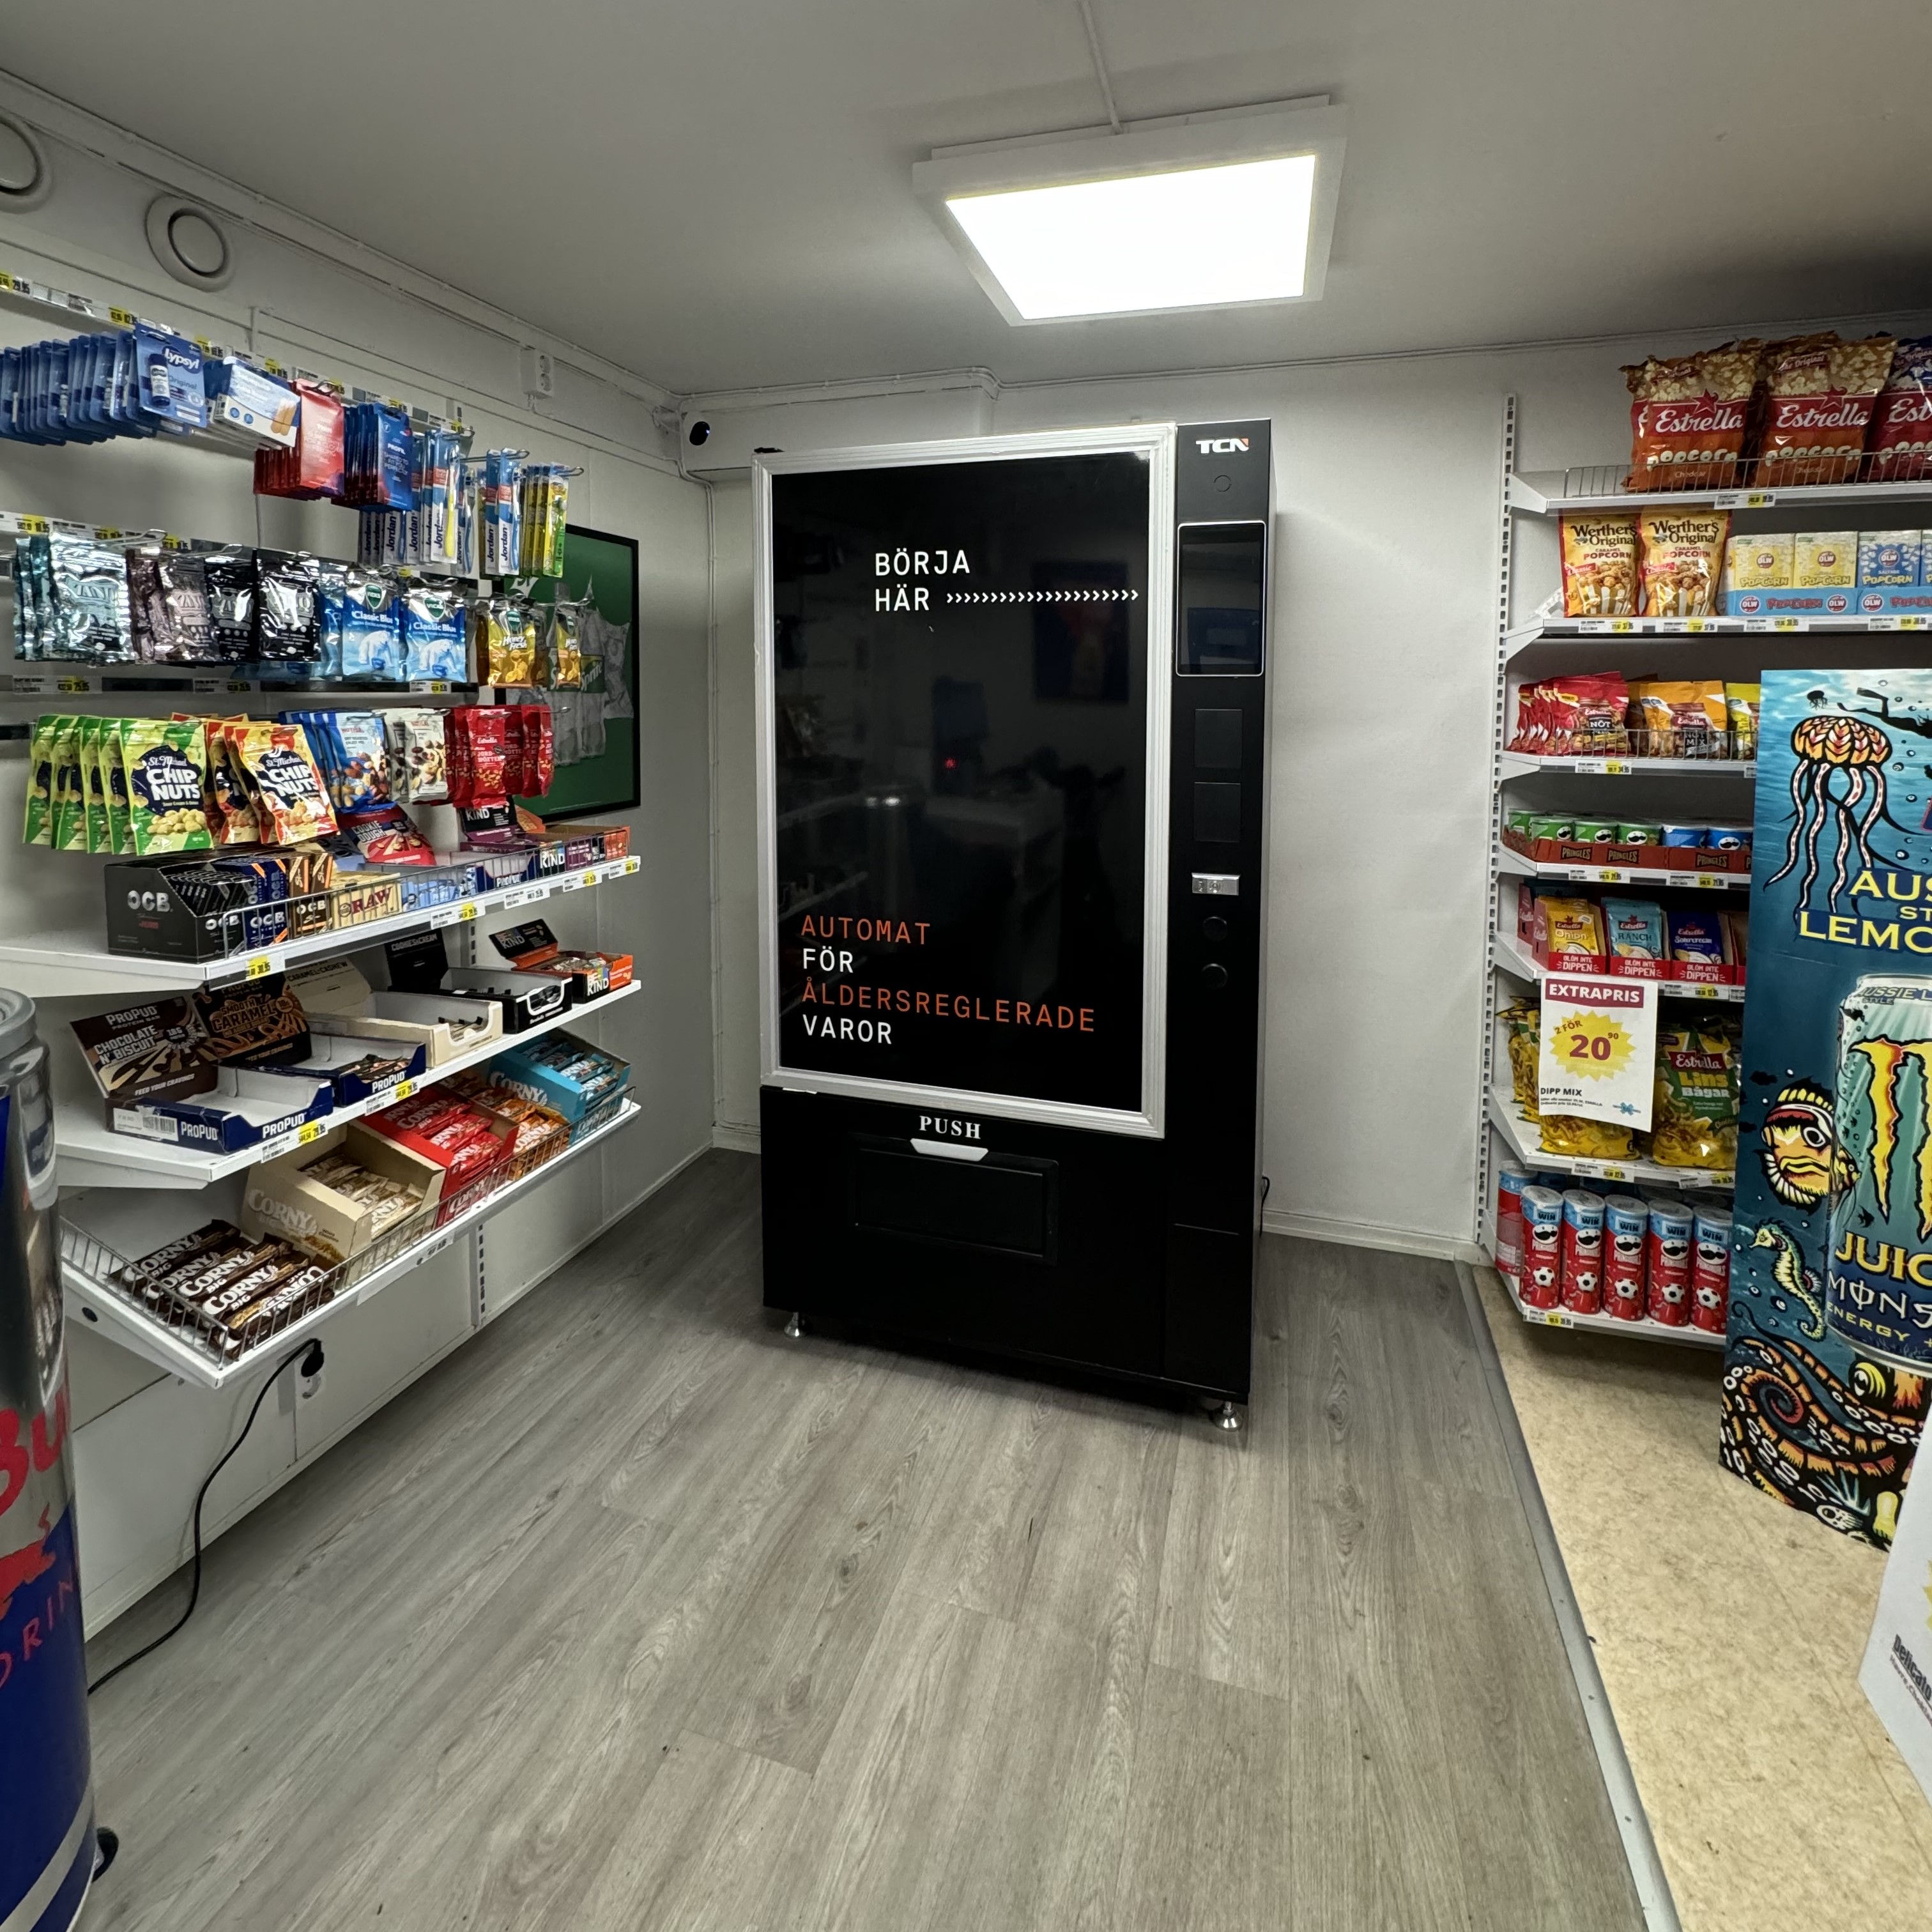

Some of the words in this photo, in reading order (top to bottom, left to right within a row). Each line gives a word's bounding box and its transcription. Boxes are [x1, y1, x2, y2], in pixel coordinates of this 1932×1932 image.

[164, 348, 200, 369] Lypsyl
[1656, 407, 1743, 433] Estrella
[1776, 404, 1869, 429] Estrella
[1195, 438, 1249, 454] TCN
[387, 515, 397, 551] Jordan
[409, 515, 418, 552] Jordan
[1570, 523, 1637, 537] Werther's
[1649, 519, 1719, 533] Werther's
[1589, 535, 1636, 547] Original
[1669, 532, 1717, 546] Original
[875, 548, 970, 576] BÖRJA
[1584, 552, 1631, 560] POPCORN
[1662, 551, 1711, 559] POPCORN
[875, 583, 929, 611] HÄR
[351, 610, 379, 622] Classic
[413, 622, 441, 632] Classic
[1590, 717, 1611, 728] NÖT
[1677, 716, 1705, 726] Estrella
[146, 768, 197, 785] CHIP
[268, 765, 312, 781] CHIP
[150, 784, 201, 801] NUTS
[276, 779, 319, 797] NUTS
[466, 808, 490, 821] KIND
[353, 820, 383, 834] COOKIE
[357, 830, 387, 843] DOUGH
[540, 853, 565, 869] KIND
[1561, 847, 1591, 861] PRINGLES
[1608, 849, 1637, 862] PRINGLES
[1697, 854, 1728, 868] PRINGLES
[1848, 870, 1932, 902] AU
[128, 890, 171, 912] OCB
[296, 900, 326, 914] OCB
[351, 885, 393, 914] RAW
[205, 914, 240, 931] OCB
[250, 911, 285, 929] OCB
[1618, 921, 1646, 930] Estrella
[801, 915, 930, 944] AUTOMAT
[1618, 932, 1652, 942] RANCH
[499, 935, 525, 949] KIND
[802, 946, 854, 973] FÖR
[1563, 962, 1593, 972] DIPPEN
[1643, 960, 1656, 968] INTE
[1623, 965, 1656, 977] DIPPEN
[1686, 970, 1719, 981] DIPPEN
[1706, 964, 1719, 972] INTE
[587, 977, 609, 997] KIND
[1549, 984, 1640, 1003] EXTRAPRIS
[1858, 987, 1917, 999] AUSSIE
[221, 998, 255, 1015] SMOOTH
[801, 976, 1094, 1032] ÅLDERSREGLERADE
[111, 1018, 145, 1030] PROTEIN
[211, 1002, 277, 1032] CARAMEL
[802, 1014, 892, 1045] VAROR
[1563, 1020, 1583, 1032] FÖR
[94, 1024, 158, 1055] CHOCOLATE
[1570, 1034, 1611, 1061] 20
[98, 1052, 111, 1066] N'
[114, 1036, 157, 1061] BISCUIT
[1675, 1054, 1722, 1070] Estrella
[135, 1086, 150, 1096] FEED
[151, 1082, 167, 1092] YOUR
[167, 1073, 195, 1087] CRAVINGS
[372, 1070, 406, 1093] PROPUD
[1678, 1071, 1729, 1086] Lins
[489, 1071, 548, 1107] CORNY
[1563, 1088, 1583, 1097] MIX
[397, 1100, 448, 1129] CORNY
[181, 1121, 219, 1141] PROPUD
[262, 1112, 305, 1138] PROPUD
[919, 1116, 981, 1139] PUSH
[249, 1189, 318, 1236] CORNY
[1582, 1217, 1599, 1225] WIN
[1620, 1222, 1639, 1231] WIN
[1667, 1227, 1685, 1236] WIN
[1703, 1230, 1722, 1241] WIN
[123, 1234, 202, 1282] CORNY
[151, 1262, 172, 1278] BIG
[178, 1250, 255, 1297] CORNY
[202, 1264, 279, 1315] CORNY
[206, 1278, 228, 1294] BIG
[231, 1294, 252, 1311] BIG
[1827, 1301, 1910, 1342] ENERGY
[1893, 1634, 1932, 1702] Delicato
